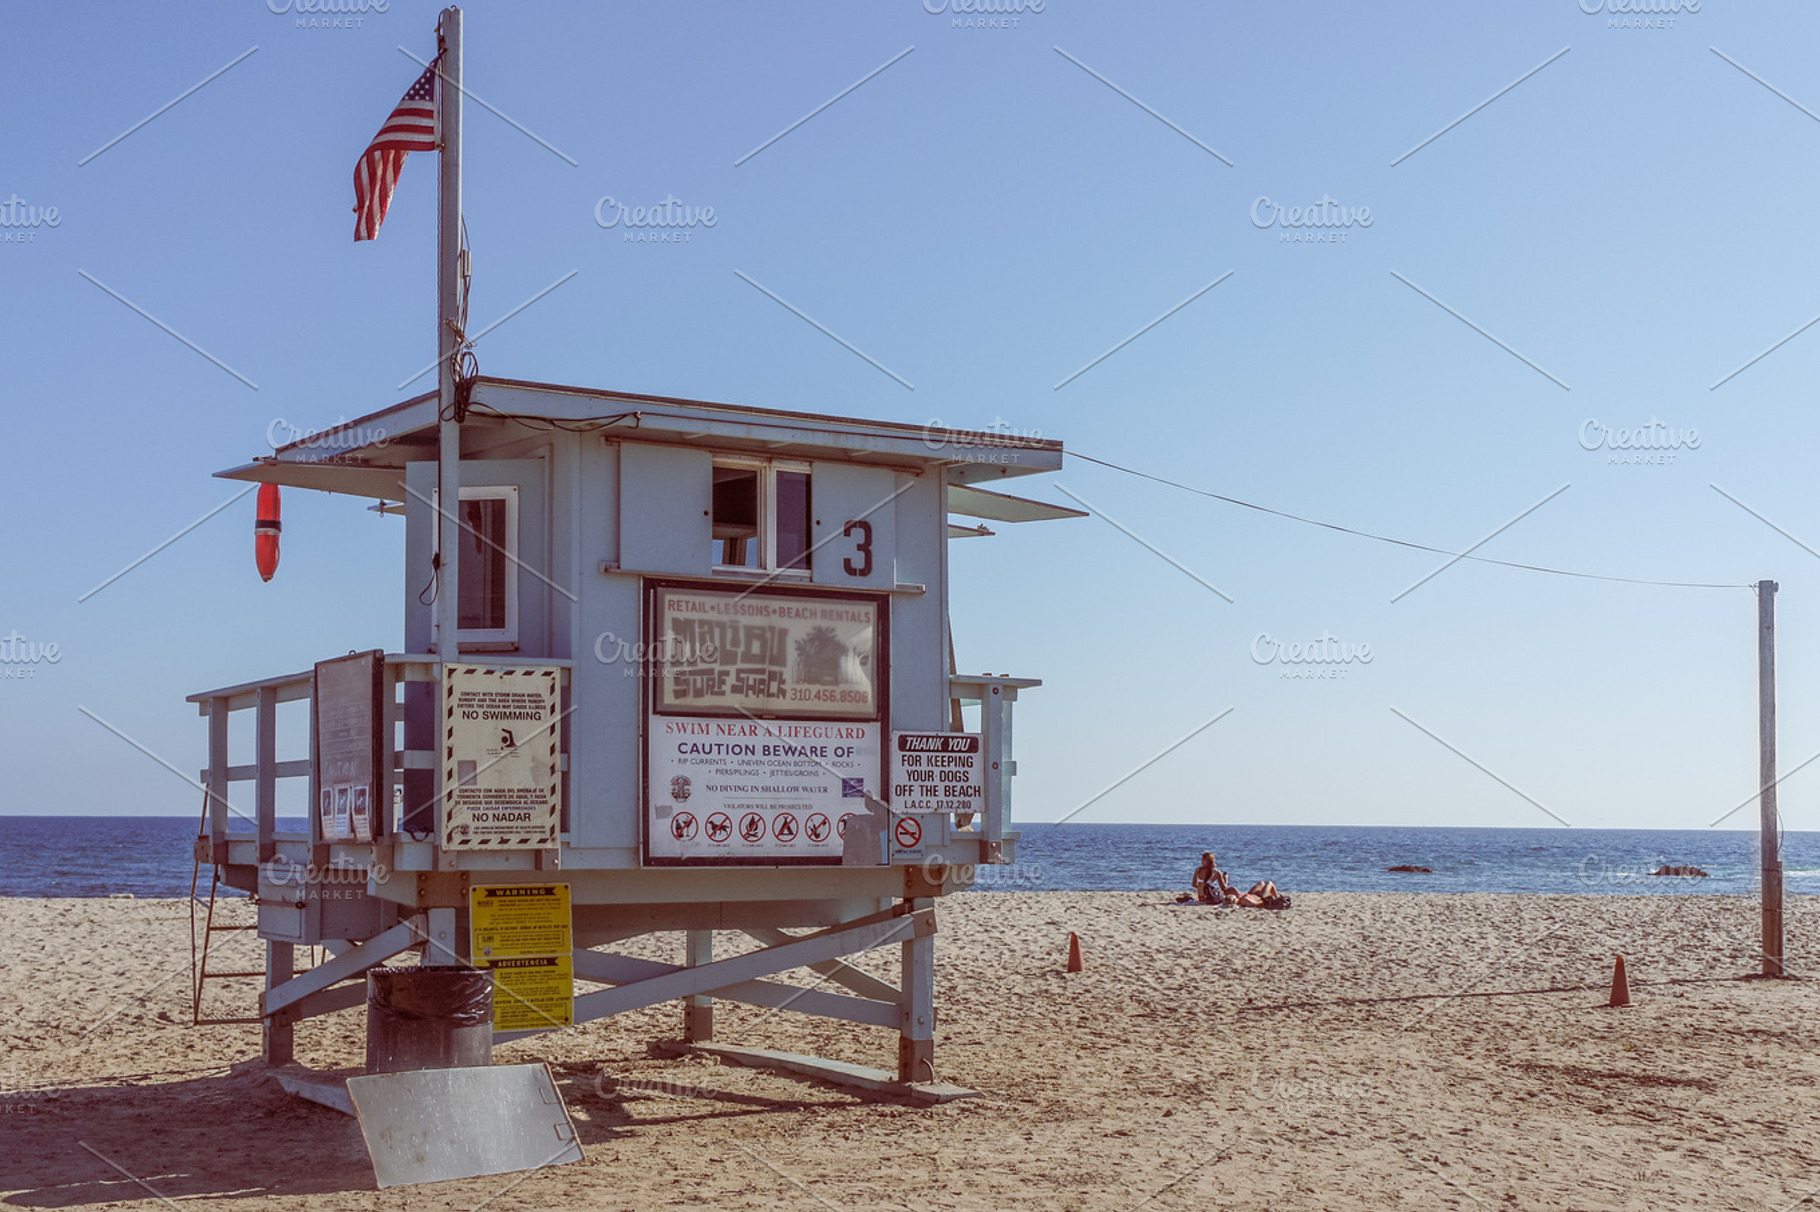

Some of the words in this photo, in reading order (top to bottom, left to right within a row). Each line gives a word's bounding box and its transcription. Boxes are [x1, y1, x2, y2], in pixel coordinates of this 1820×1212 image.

[843, 520, 872, 577] 3
[668, 599, 709, 614] RETAIL
[717, 604, 771, 617] LESSONS
[778, 606, 818, 620] BEACH
[820, 609, 871, 623] RENTALS
[673, 668, 730, 699] SURF
[731, 668, 788, 700] SHACK
[462, 710, 479, 720] NO
[482, 710, 542, 721] SWIMMING
[666, 721, 710, 736] SWIM
[716, 723, 758, 737] NEAR
[764, 725, 775, 738] A
[778, 725, 866, 740] LIFEGUARD
[677, 742, 756, 756] CAUTION
[762, 744, 828, 758] BEWARE
[833, 746, 854, 758] OF
[905, 736, 944, 751] THANK
[948, 737, 971, 751] YOU
[690, 758, 727, 766] CURRENTS
[737, 759, 765, 767] UNEVEN
[793, 760, 821, 768] BOTTOM
[901, 754, 922, 767] FOR
[926, 755, 974, 768] KEEPING
[906, 769, 935, 782] YOUR
[939, 770, 970, 783] DOGS
[705, 784, 718, 792] NO
[719, 784, 749, 793] DIVING
[750, 785, 760, 793] IN
[761, 785, 800, 793] SHALLOW
[801, 785, 829, 793] WATER
[894, 784, 915, 797] OFF
[919, 785, 939, 797] THE
[944, 785, 981, 798] BEACH
[472, 812, 489, 822] NO
[492, 812, 531, 822] NADAR
[495, 888, 546, 896] WARNING
[497, 958, 548, 967] ADVERTENCIA
